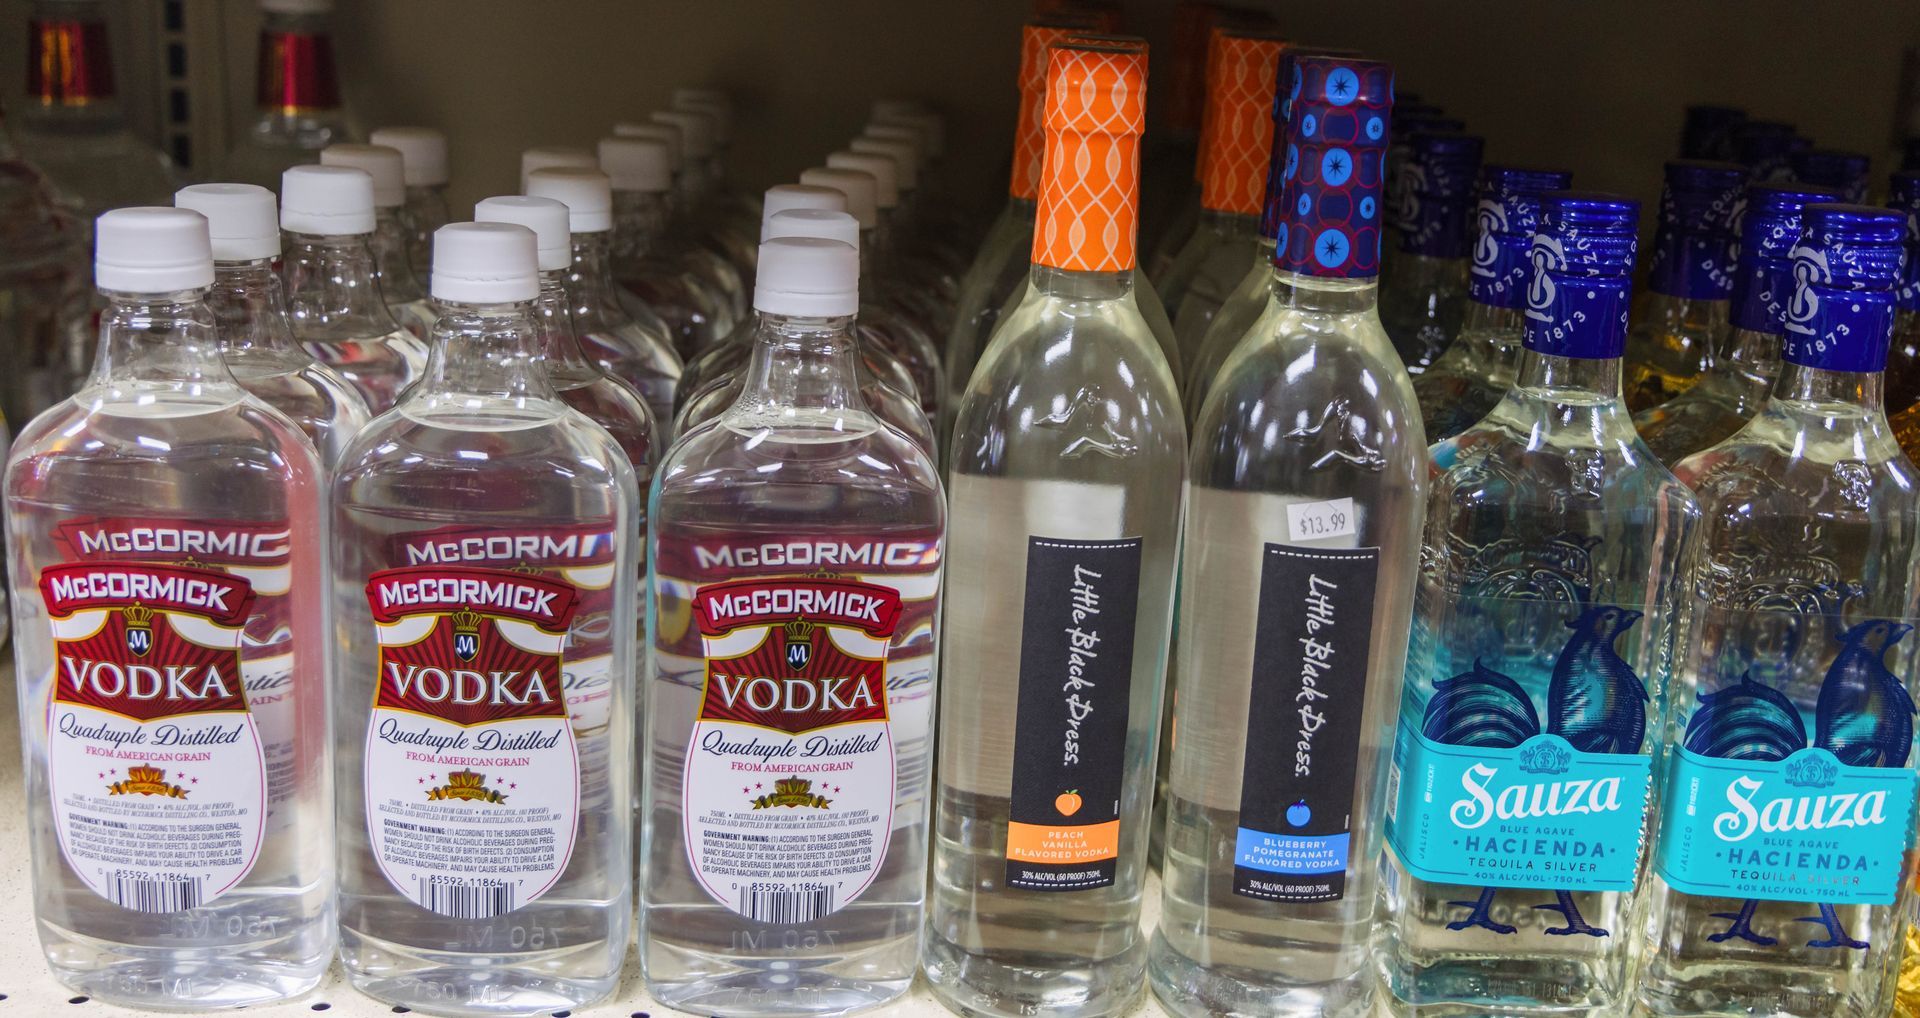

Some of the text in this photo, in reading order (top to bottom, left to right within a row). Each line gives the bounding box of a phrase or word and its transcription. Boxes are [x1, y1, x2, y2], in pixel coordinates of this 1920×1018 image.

[1558, 221, 1600, 277] SAUZA
[1759, 214, 1801, 258] TEQU
[1824, 233, 1866, 290] SAUZA
[1487, 267, 1524, 296] 1873
[1760, 290, 1788, 323] DES
[1545, 311, 1586, 343] 1873
[1807, 323, 1850, 355] 1873
[1301, 511, 1346, 537] $13.99
[79, 527, 292, 557] McCORMIC
[693, 541, 922, 571] McCORMIC
[51, 572, 233, 611] McCORMICK
[380, 578, 558, 617] McCORMICK
[709, 588, 888, 623] McCORMICK
[1069, 563, 1102, 625] Little
[1304, 572, 1337, 635] Little
[1063, 627, 1101, 692] Black
[1298, 636, 1335, 703] Black
[61, 656, 234, 700] VODKA
[386, 661, 554, 705] VODKA
[712, 673, 878, 712] VODKA
[59, 712, 245, 750] Quadruple Distilled
[378, 718, 562, 754] Quadruple Distilled
[702, 729, 884, 763] Quadruple Distilled
[86, 745, 211, 762] FROM AMERICAN GRAIN
[406, 751, 530, 767] FROM AMERICAN GRAIN
[731, 761, 853, 773] FROM AMERICAN GRAIN
[1450, 761, 1622, 830] Sauza
[1713, 775, 1887, 842] Sauza
[1042, 840, 1088, 850] VANILLA
[1048, 831, 1084, 840] PEACH
[1263, 838, 1327, 850] BLUEBERRY
[1420, 813, 1430, 860] JALISCO
[1500, 824, 1575, 837] BLUE AGAVE
[1763, 837, 1839, 851] BLUE AGAVE
[1015, 846, 1110, 859] FLAVORED VODKA
[1244, 854, 1340, 869] FLAVORED VODKA
[1253, 846, 1335, 859] POMEGRANATE
[1464, 835, 1606, 859] HACIENDA
[1680, 826, 1692, 872] JALISCO
[1727, 848, 1869, 872] HACIENDA
[116, 869, 149, 880] 85592
[155, 872, 189, 882] 11864
[1469, 856, 1597, 873] TEQUILA SILVER
[1474, 871, 1495, 881] 40%
[1498, 873, 1546, 884] ALC/VOL
[1553, 875, 1573, 885] 750
[1730, 869, 1860, 886] TEQUILA SILVER
[429, 874, 463, 886] 85592
[469, 877, 503, 887] 11864
[751, 882, 786, 892] 85592
[791, 881, 824, 892] 11864
[1249, 879, 1331, 894] 30% ALC/VOL (60 PROOF) 750ML
[1736, 884, 1758, 893] 40%
[1761, 885, 1808, 897] ALC/VOL
[1816, 887, 1836, 897] 750
